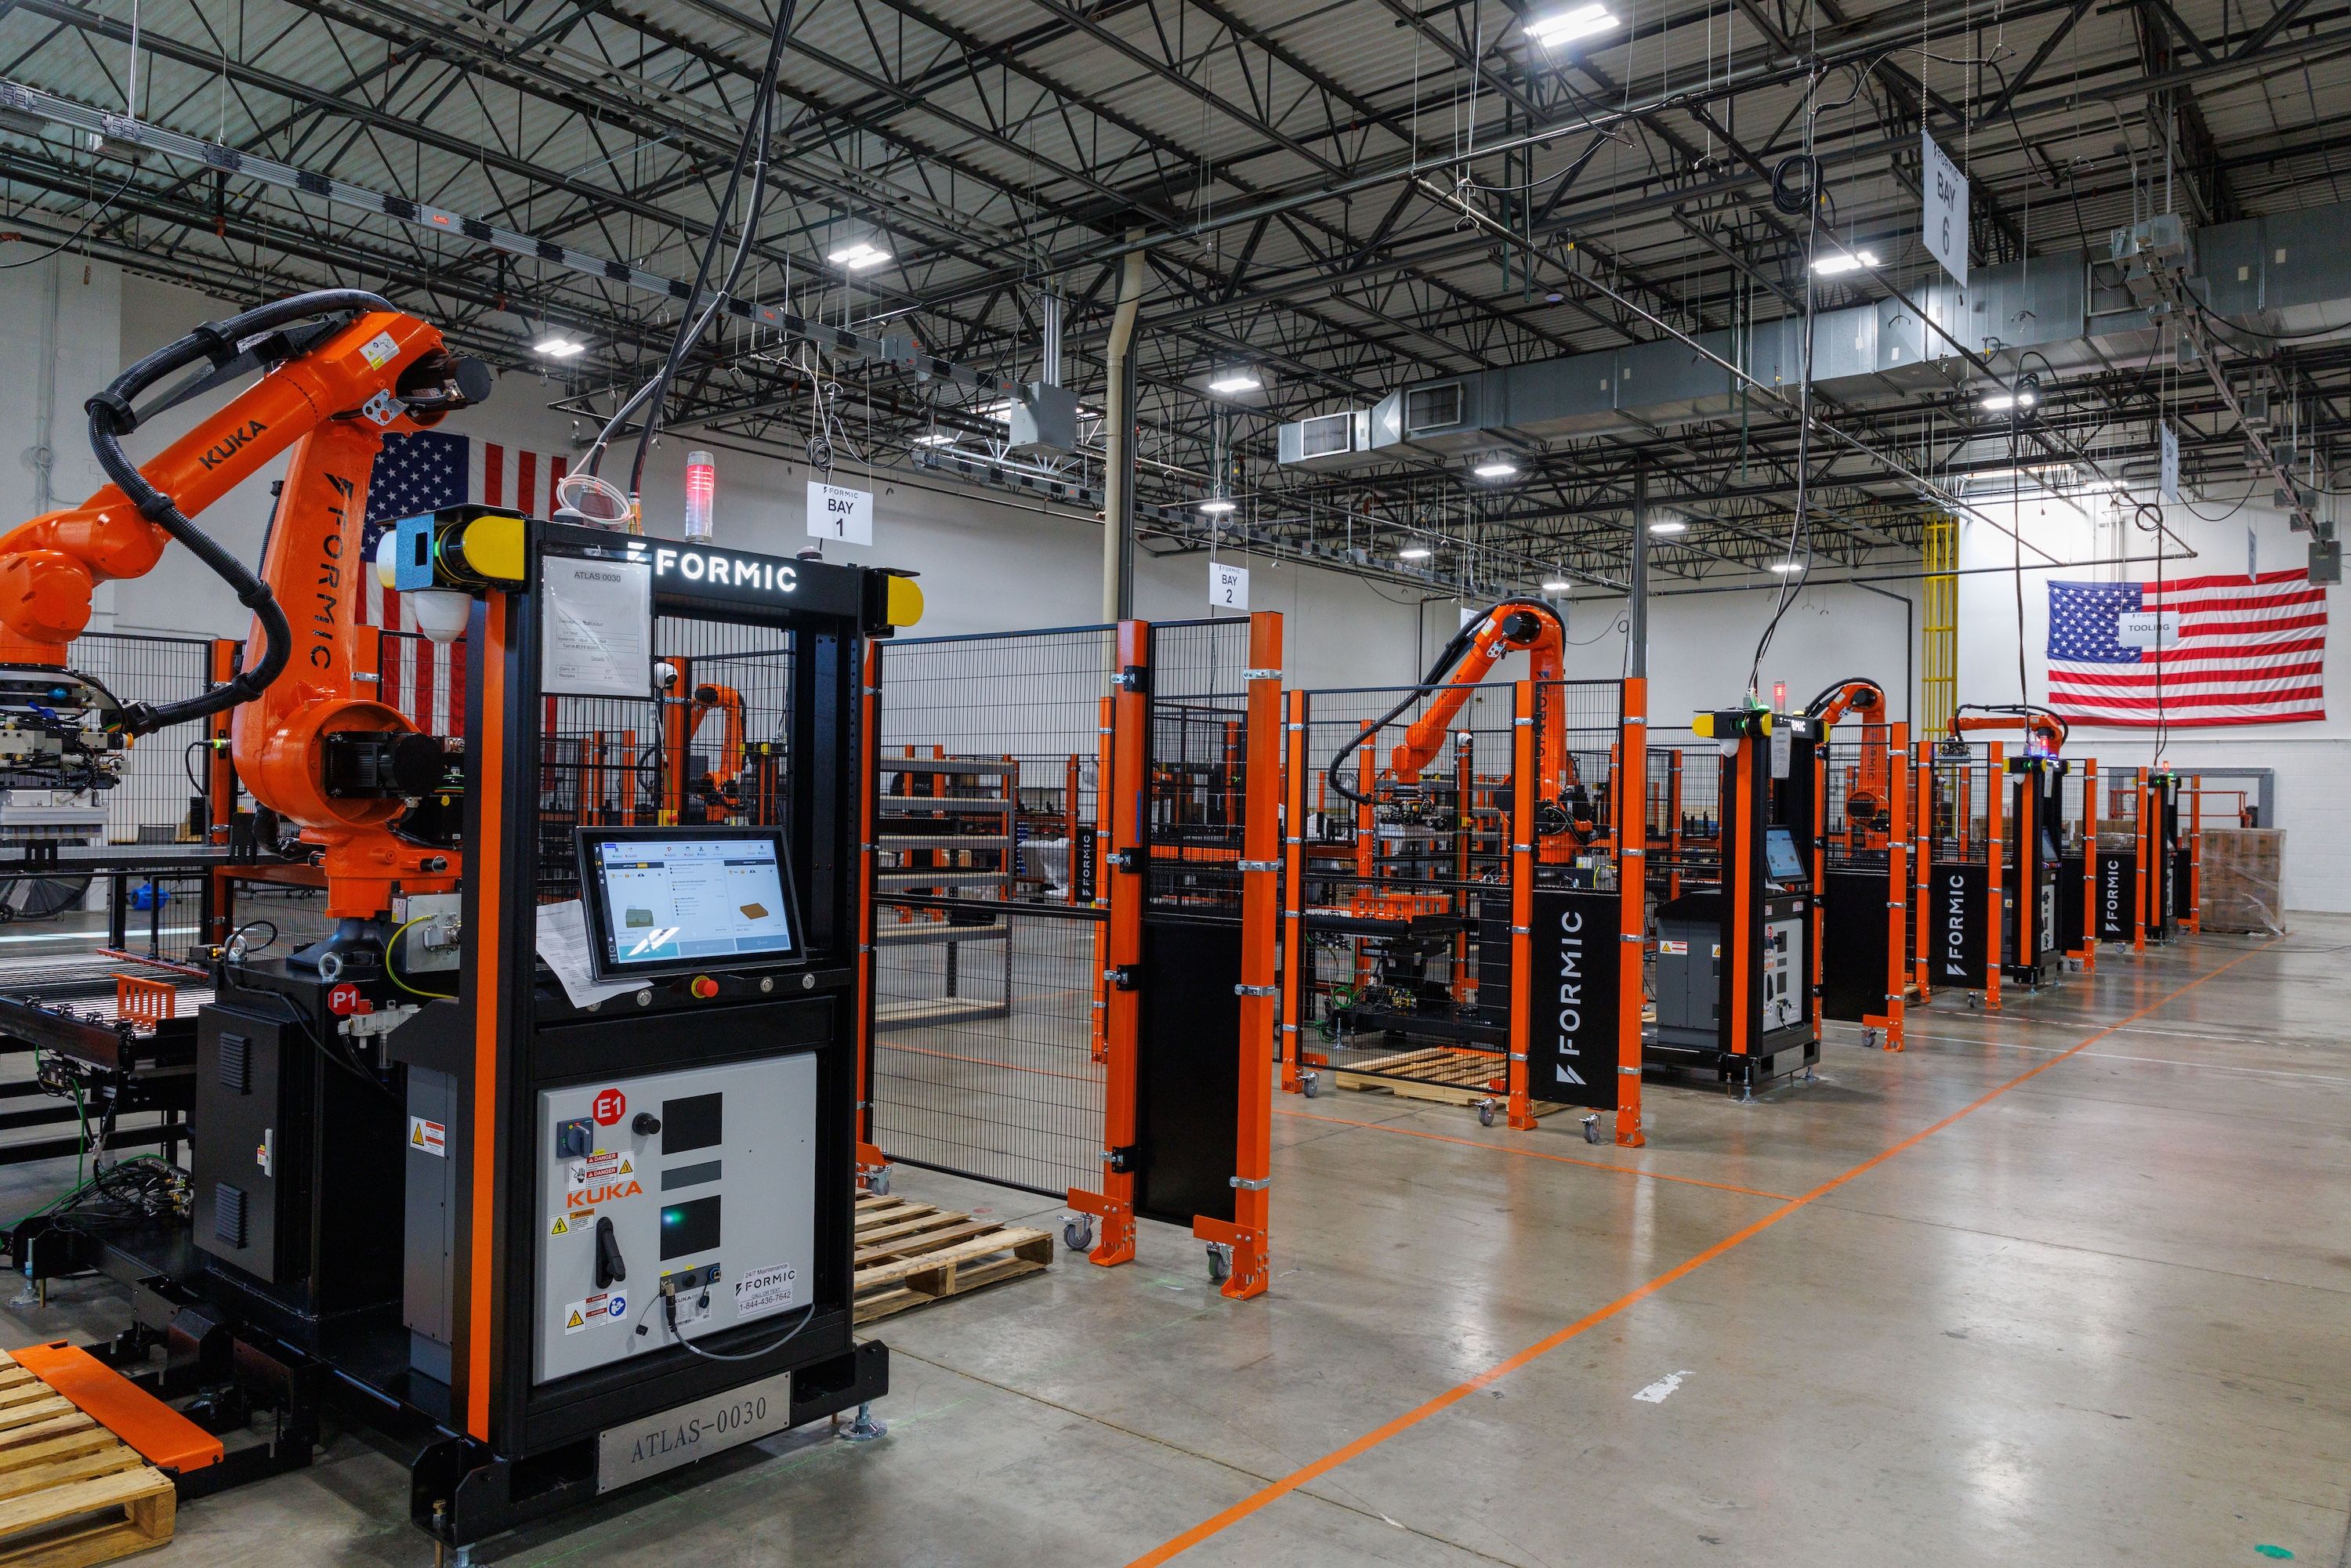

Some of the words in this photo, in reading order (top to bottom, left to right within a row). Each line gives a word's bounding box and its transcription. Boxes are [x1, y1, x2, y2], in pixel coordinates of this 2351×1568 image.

[1938, 151, 1958, 182] FORMIC
[1937, 170, 1955, 212] BAY
[1943, 215, 1950, 256] 6
[198, 420, 268, 470] KUKA
[829, 487, 859, 499] FORMIC
[828, 498, 853, 514] BAY
[835, 518, 843, 537] 1
[574, 571, 600, 581] ATLAS
[602, 574, 621, 582] 0030
[656, 549, 797, 592] FORMIC
[1222, 574, 1237, 586] BAY
[310, 506, 347, 670] FORMIC
[1226, 588, 1233, 603] 2
[2106, 860, 2119, 920] FORMIC
[1949, 875, 1964, 959] FORMIC
[1559, 911, 1583, 1056] FORMIC
[333, 990, 357, 1009] P1
[598, 1096, 621, 1118] E1
[594, 1153, 617, 1162] DANGER
[594, 1168, 616, 1176] DANGER
[567, 1181, 643, 1208] KUKA
[757, 1263, 788, 1275] Maintenance
[745, 1270, 795, 1291] FORMIC
[740, 1291, 791, 1310] 1-844-436-7642
[631, 1396, 766, 1464] ATLAS-0030
